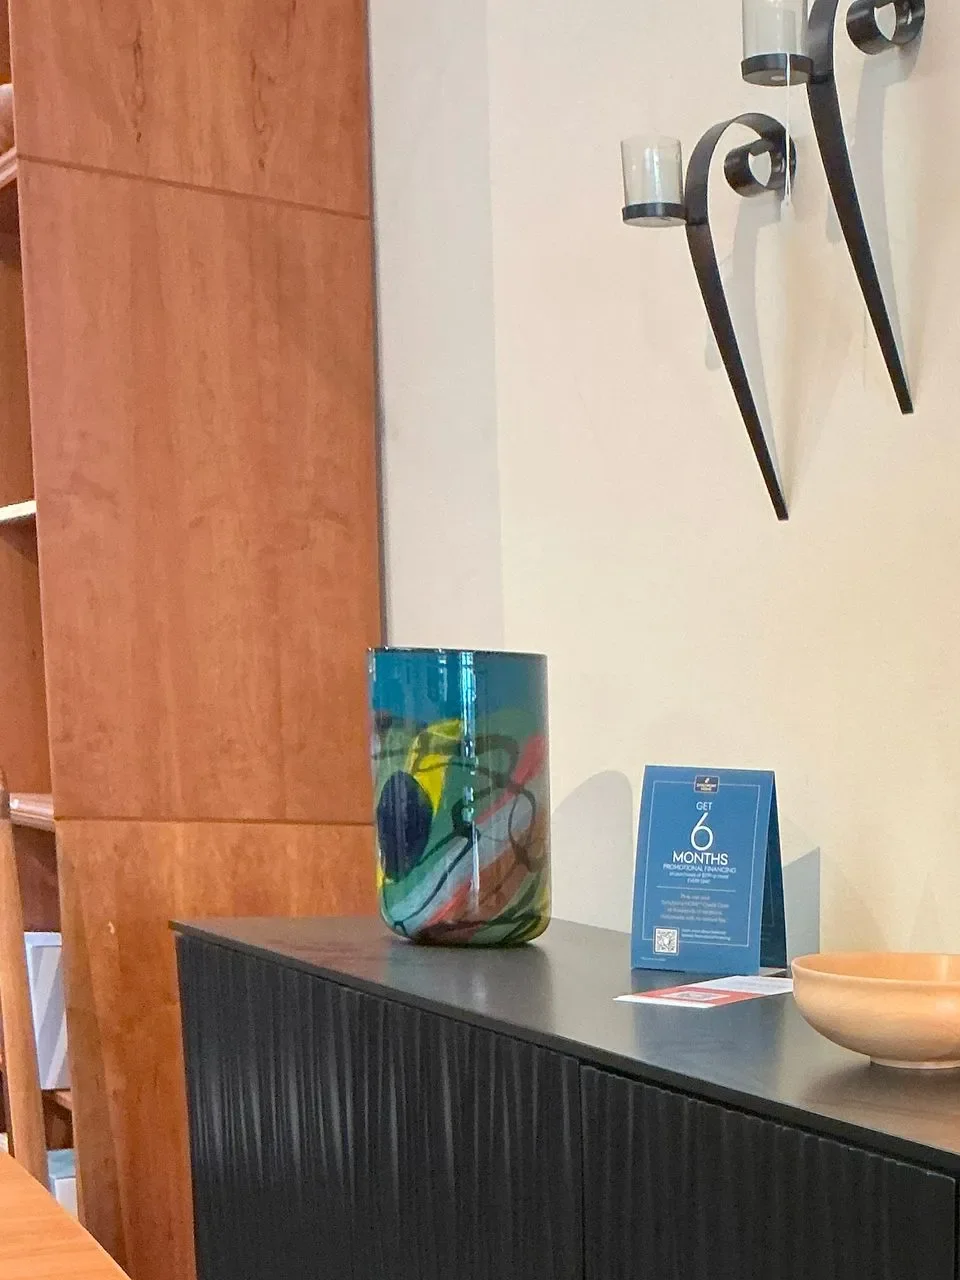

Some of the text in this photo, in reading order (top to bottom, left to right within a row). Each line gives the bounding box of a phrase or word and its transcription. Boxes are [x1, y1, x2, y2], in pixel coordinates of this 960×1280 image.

[696, 802, 713, 811] GET
[690, 812, 714, 851] 6
[672, 851, 729, 865] MONTHS
[663, 864, 737, 874] PROMOTIONAL FINANCING
